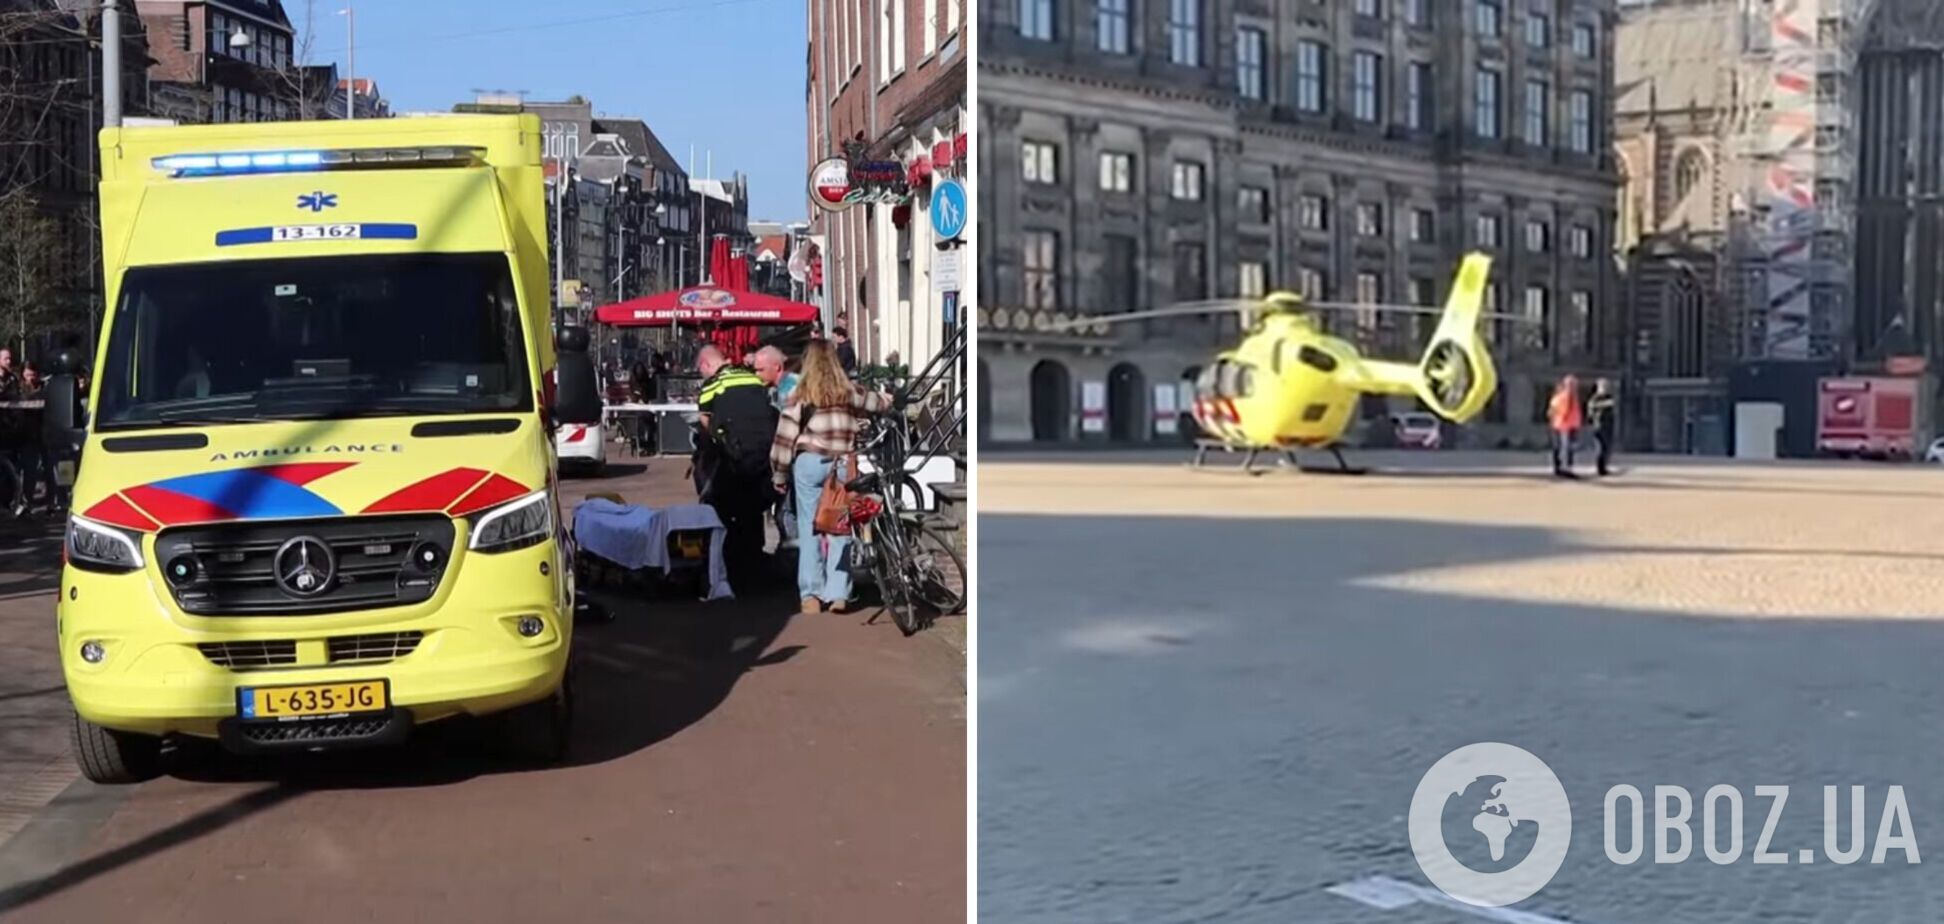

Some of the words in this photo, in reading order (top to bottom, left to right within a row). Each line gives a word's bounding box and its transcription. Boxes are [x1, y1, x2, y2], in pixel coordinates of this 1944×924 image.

[278, 225, 357, 239] 13-162
[633, 310, 654, 319] BIG
[655, 310, 692, 318] SHOTS
[693, 310, 713, 318] Bar
[721, 310, 781, 318] Restaurant
[210, 444, 404, 462] AMBULANCE
[266, 686, 374, 714] L-635-JG
